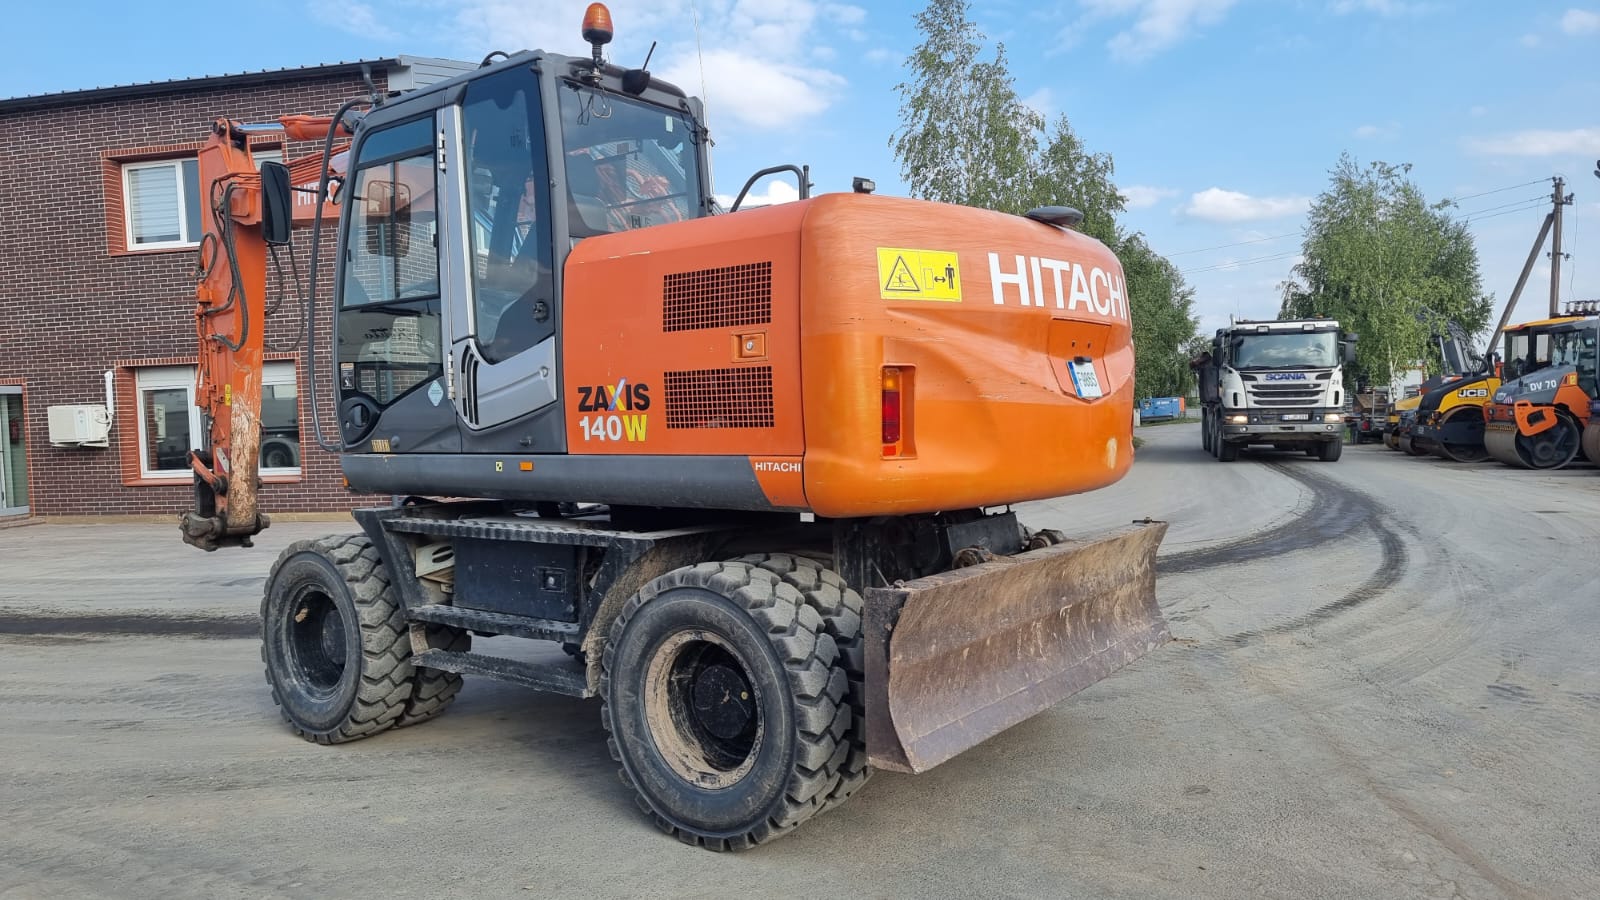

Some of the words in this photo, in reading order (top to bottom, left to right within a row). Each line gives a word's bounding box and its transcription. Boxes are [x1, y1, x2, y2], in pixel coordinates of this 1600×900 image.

[988, 252, 1128, 320] HITACHI
[1265, 372, 1307, 380] SCANIA
[1529, 382, 1543, 391] DV
[1545, 379, 1557, 389] 70
[577, 377, 650, 412] ZAXIS
[1458, 389, 1487, 397] JCB
[579, 414, 648, 442] 140W
[754, 461, 801, 473] HITACHI
